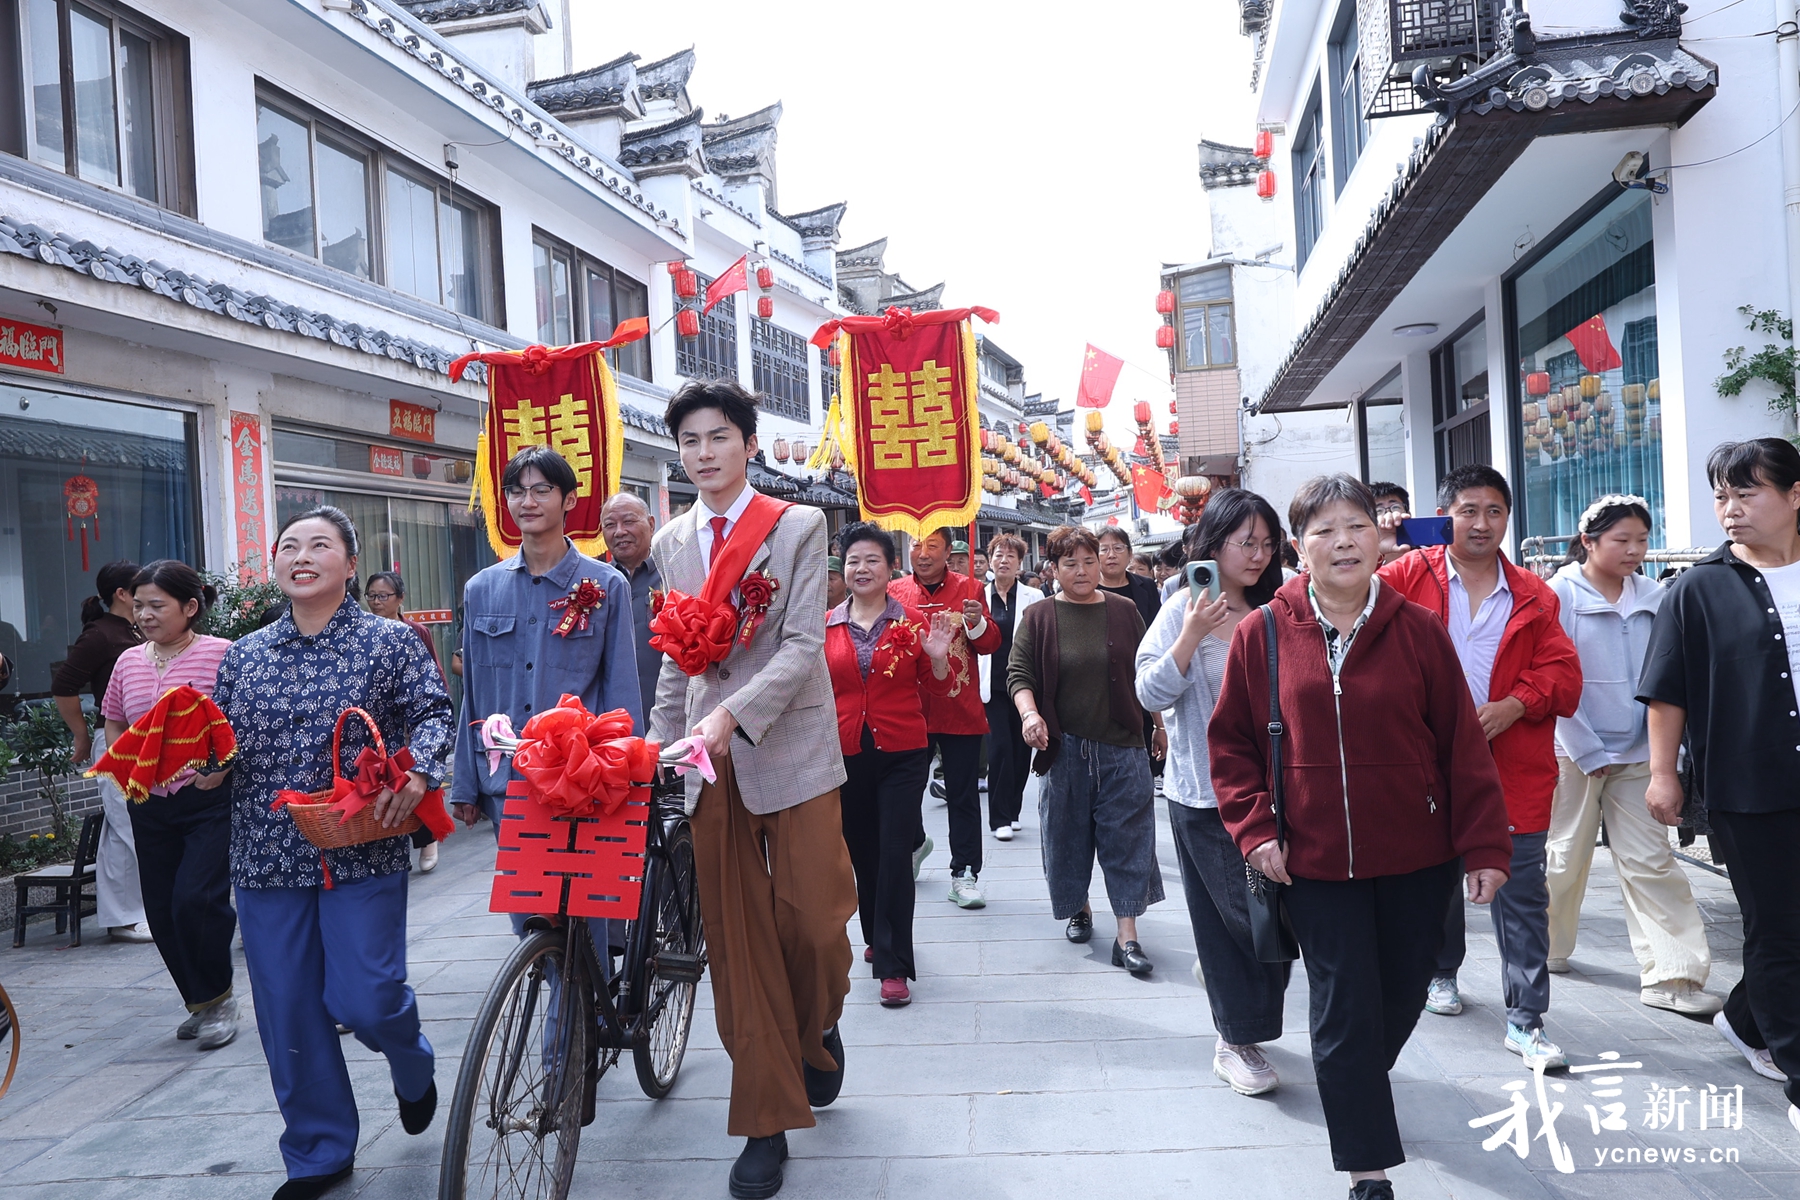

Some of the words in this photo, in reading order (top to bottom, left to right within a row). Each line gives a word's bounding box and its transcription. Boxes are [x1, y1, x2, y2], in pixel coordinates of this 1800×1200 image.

[392, 407, 432, 436] 五福臨門
[868, 359, 958, 470] 囍
